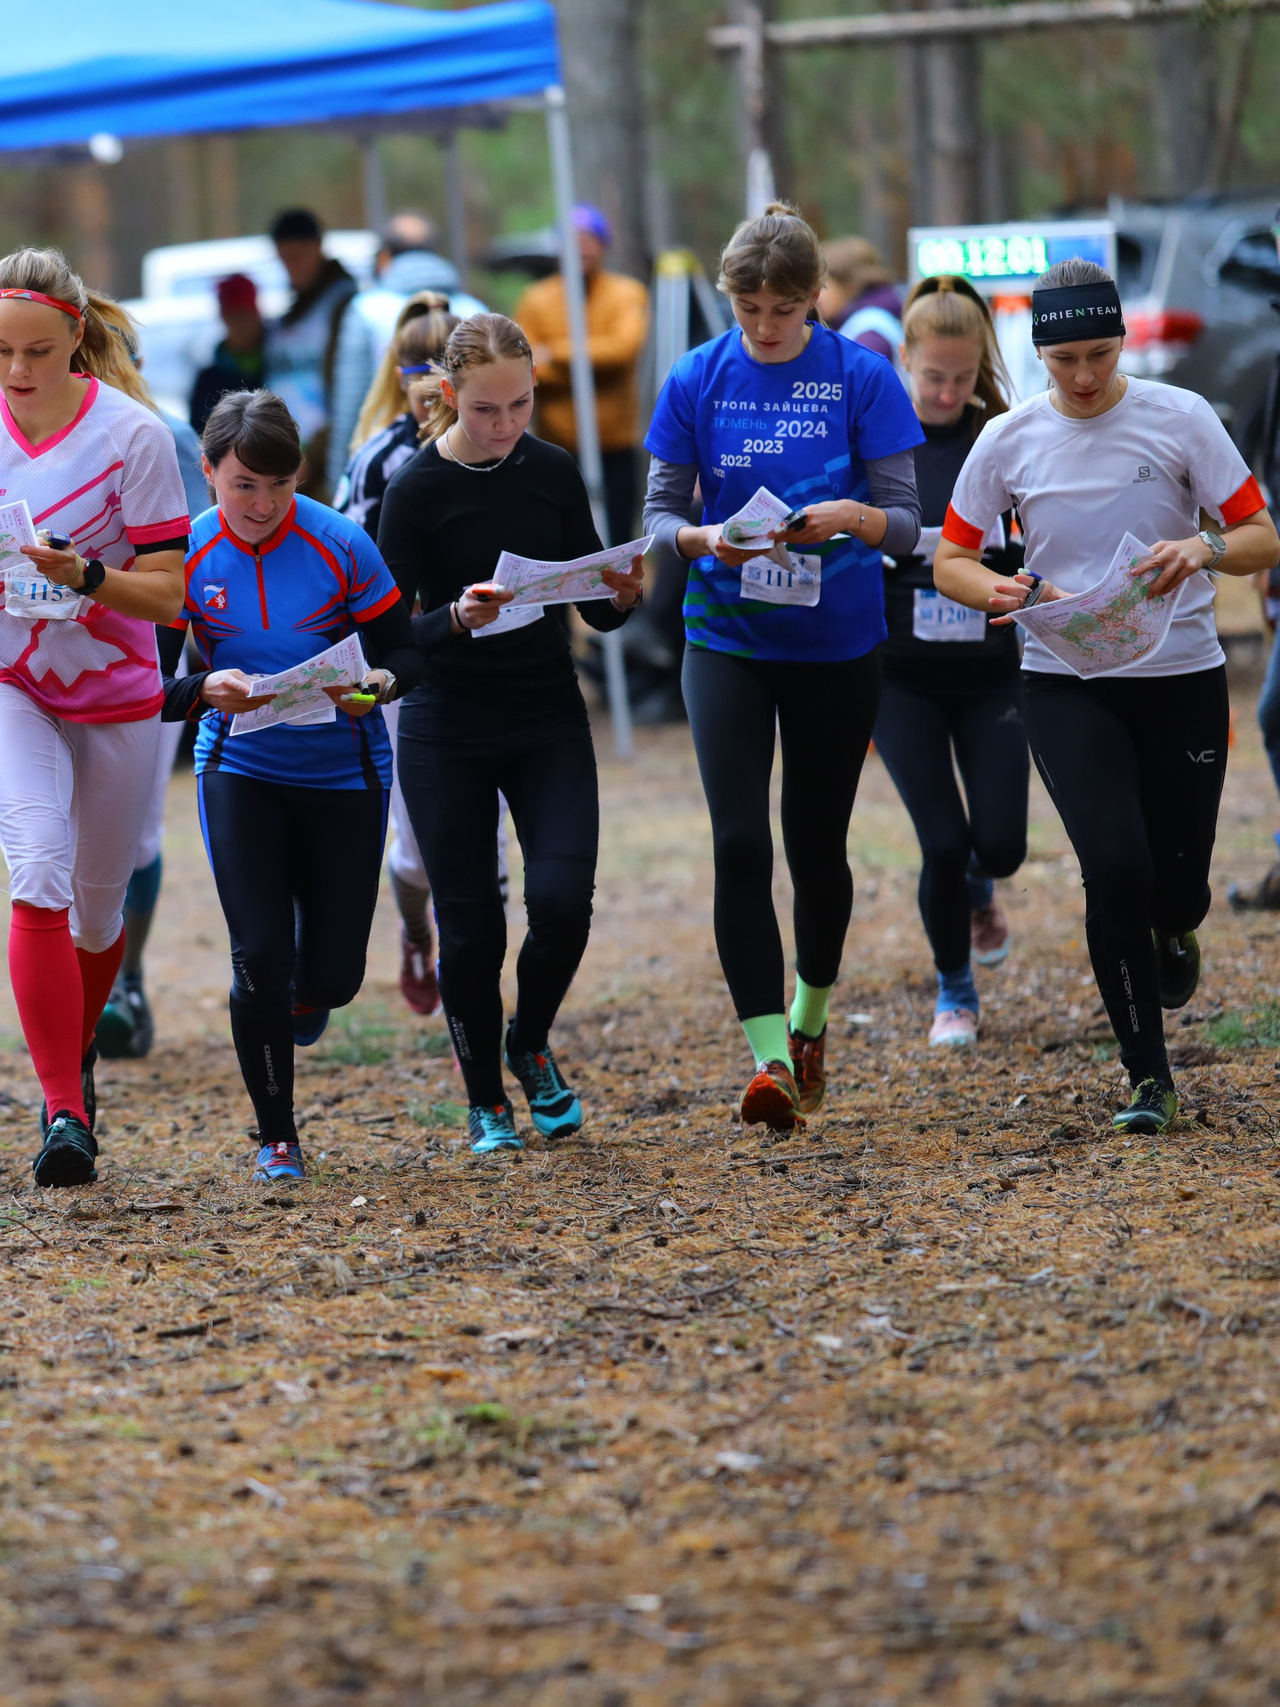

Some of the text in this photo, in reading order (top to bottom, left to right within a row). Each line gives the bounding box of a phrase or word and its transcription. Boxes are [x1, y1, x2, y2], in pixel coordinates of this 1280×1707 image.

[1040, 306, 1118, 323] ORIENTEAM
[791, 382, 843, 401] 2025
[713, 401, 828, 413] ТРОПА ЗАЙЦЕВА
[713, 417, 767, 430] ТЮМЕНЬ
[774, 420, 828, 438] 2024
[742, 439, 784, 454] 2023
[720, 454, 752, 467] 2022
[766, 570, 793, 588] 111
[938, 607, 967, 624] 120
[1119, 959, 1133, 1000] VICTORY
